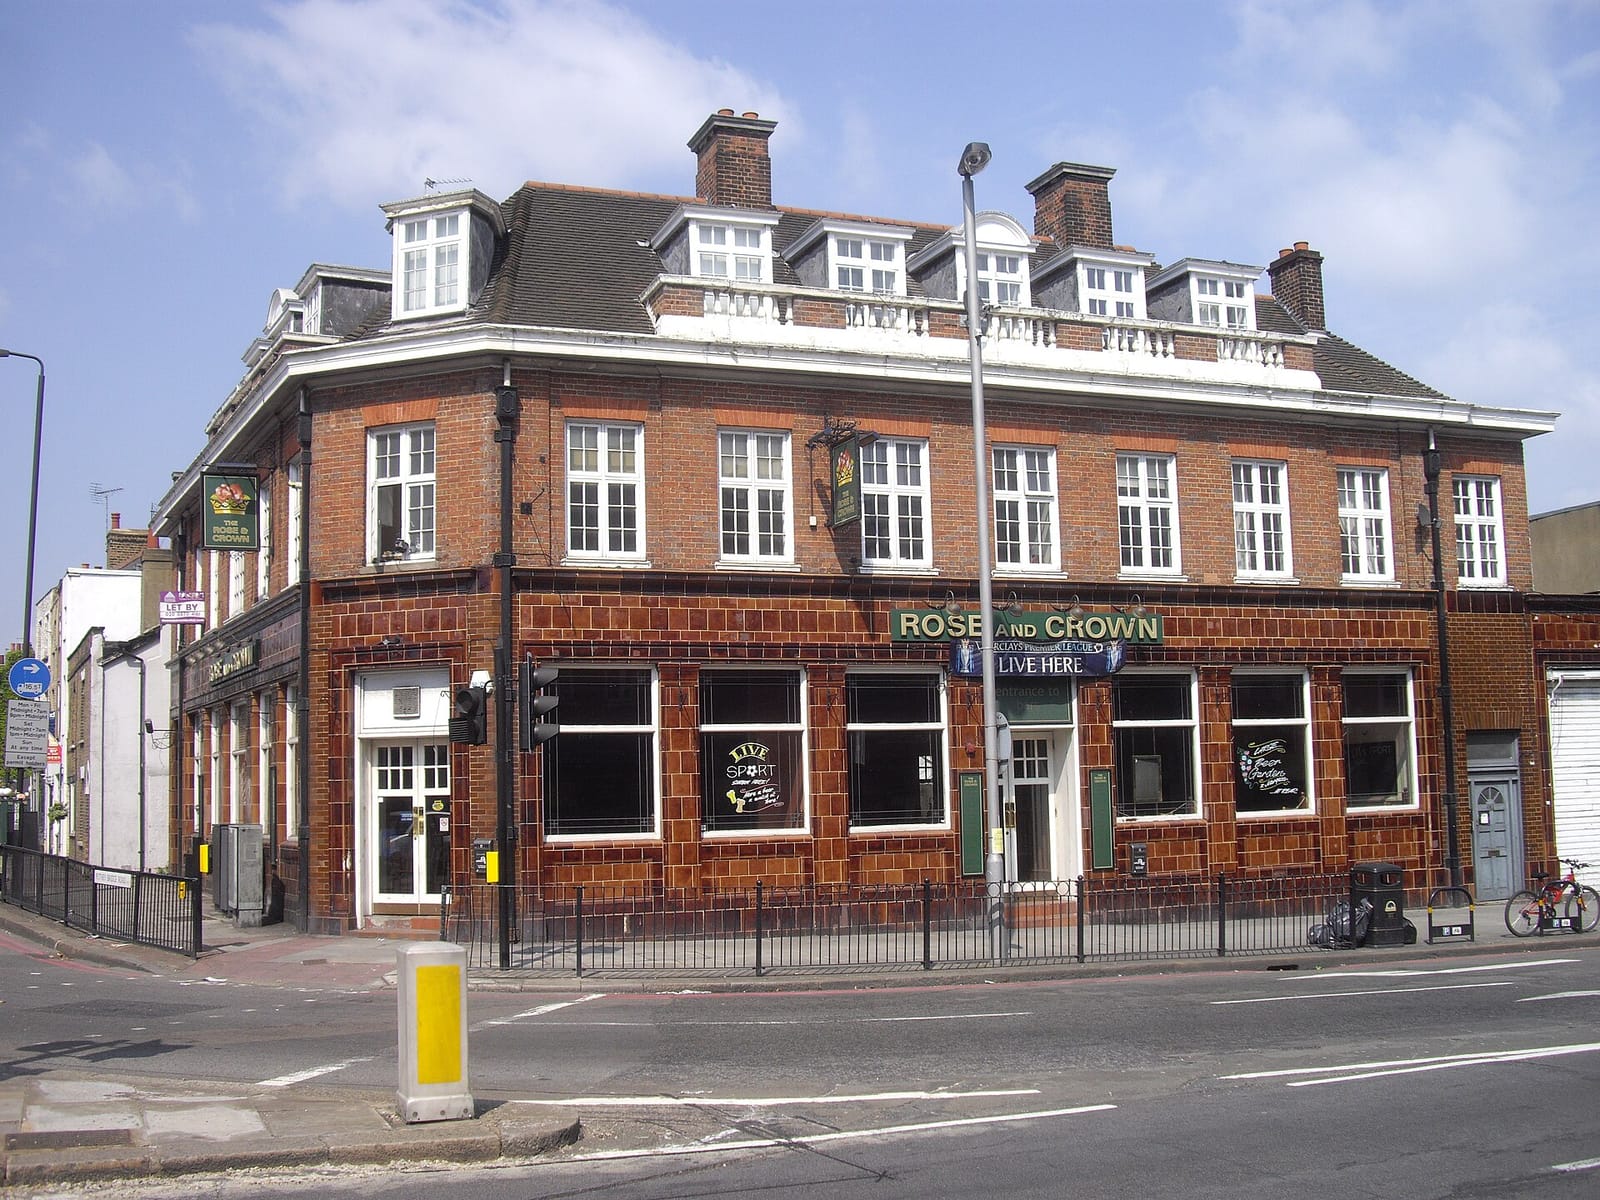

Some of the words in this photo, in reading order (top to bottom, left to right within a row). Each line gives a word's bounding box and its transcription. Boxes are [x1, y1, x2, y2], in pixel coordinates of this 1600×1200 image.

[212, 534, 250, 543] CROWN
[900, 613, 983, 638] ROSE
[994, 623, 1037, 638] AND
[1045, 615, 1158, 639] CROWN
[1062, 642, 1093, 652] LEAGUE
[999, 656, 1037, 673] LIVE
[1042, 656, 1083, 673] HERE
[996, 686, 1044, 696] entrance
[1048, 688, 1060, 696] to
[730, 744, 768, 762] LIVE
[1254, 758, 1282, 768] Beer
